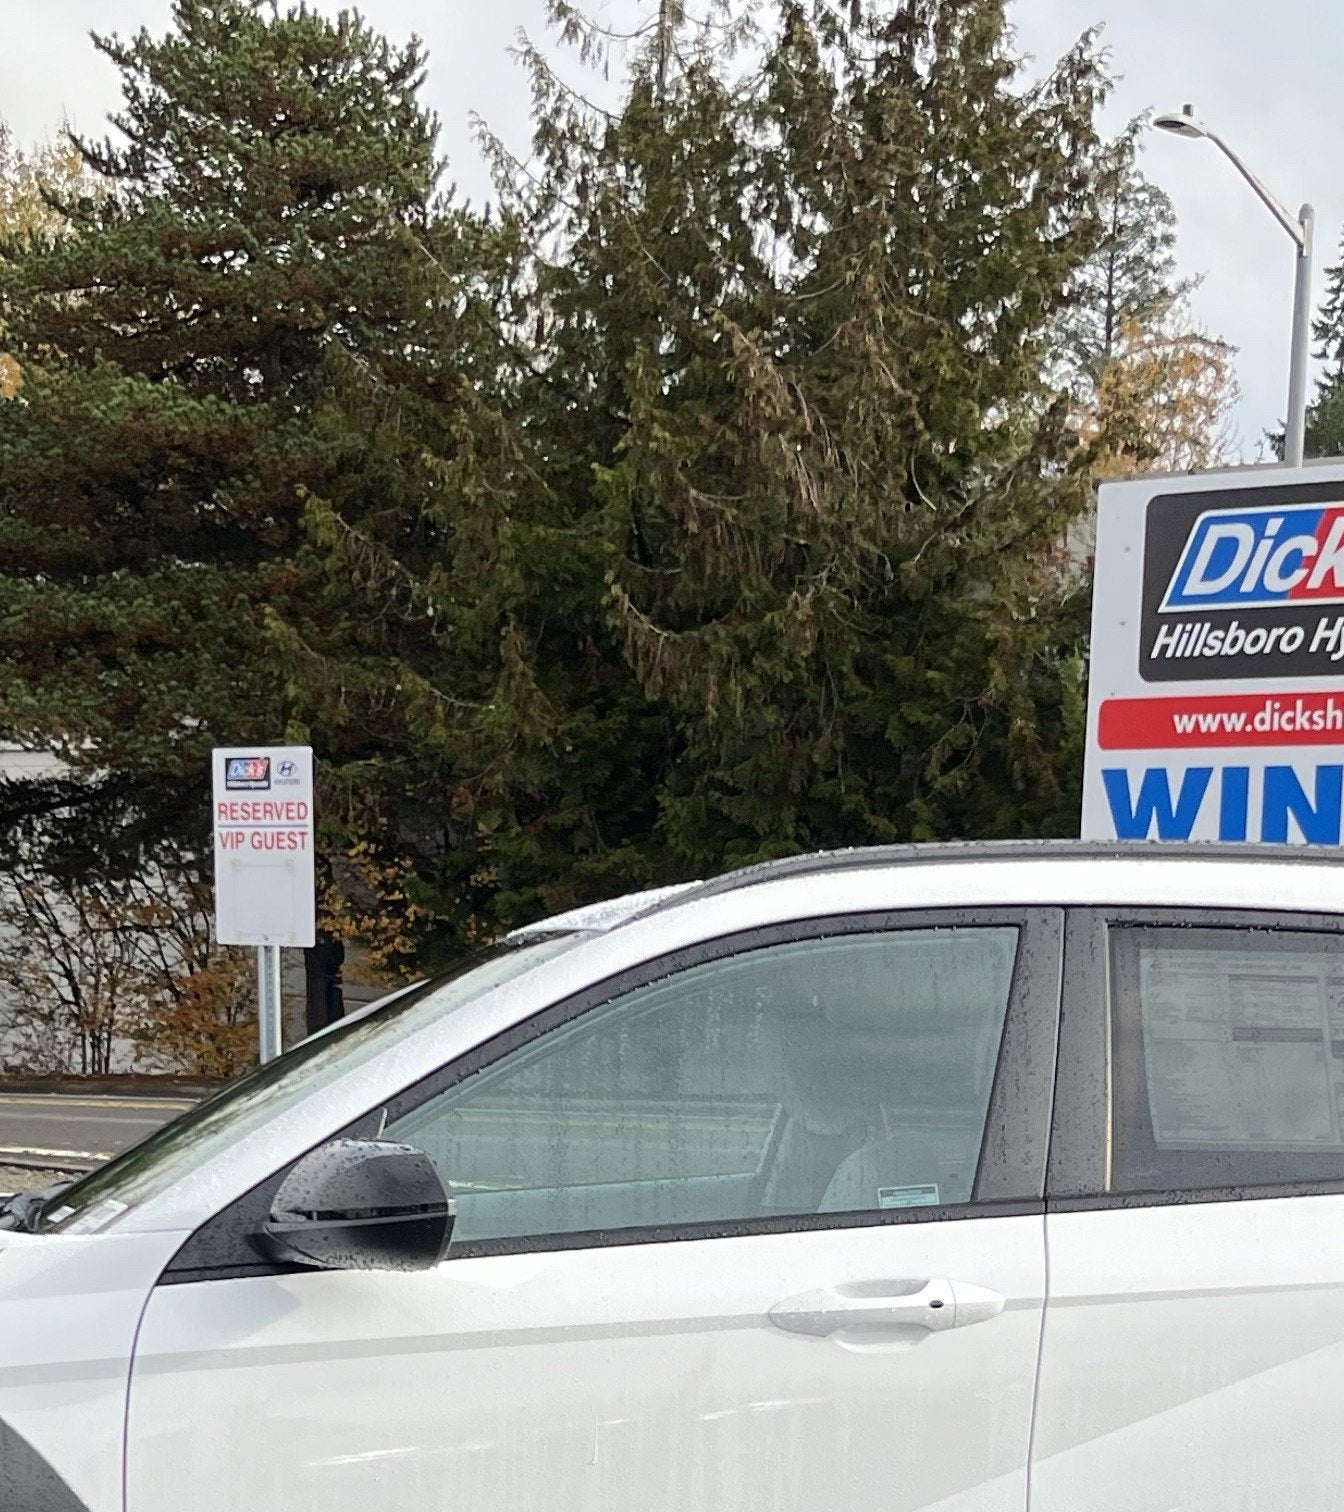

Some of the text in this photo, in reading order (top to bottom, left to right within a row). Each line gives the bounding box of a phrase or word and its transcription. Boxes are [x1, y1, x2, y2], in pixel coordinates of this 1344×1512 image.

[1151, 619, 1304, 660] Hillsboro
[217, 802, 308, 821] RESERVED
[219, 831, 308, 851] VIP GUEST
